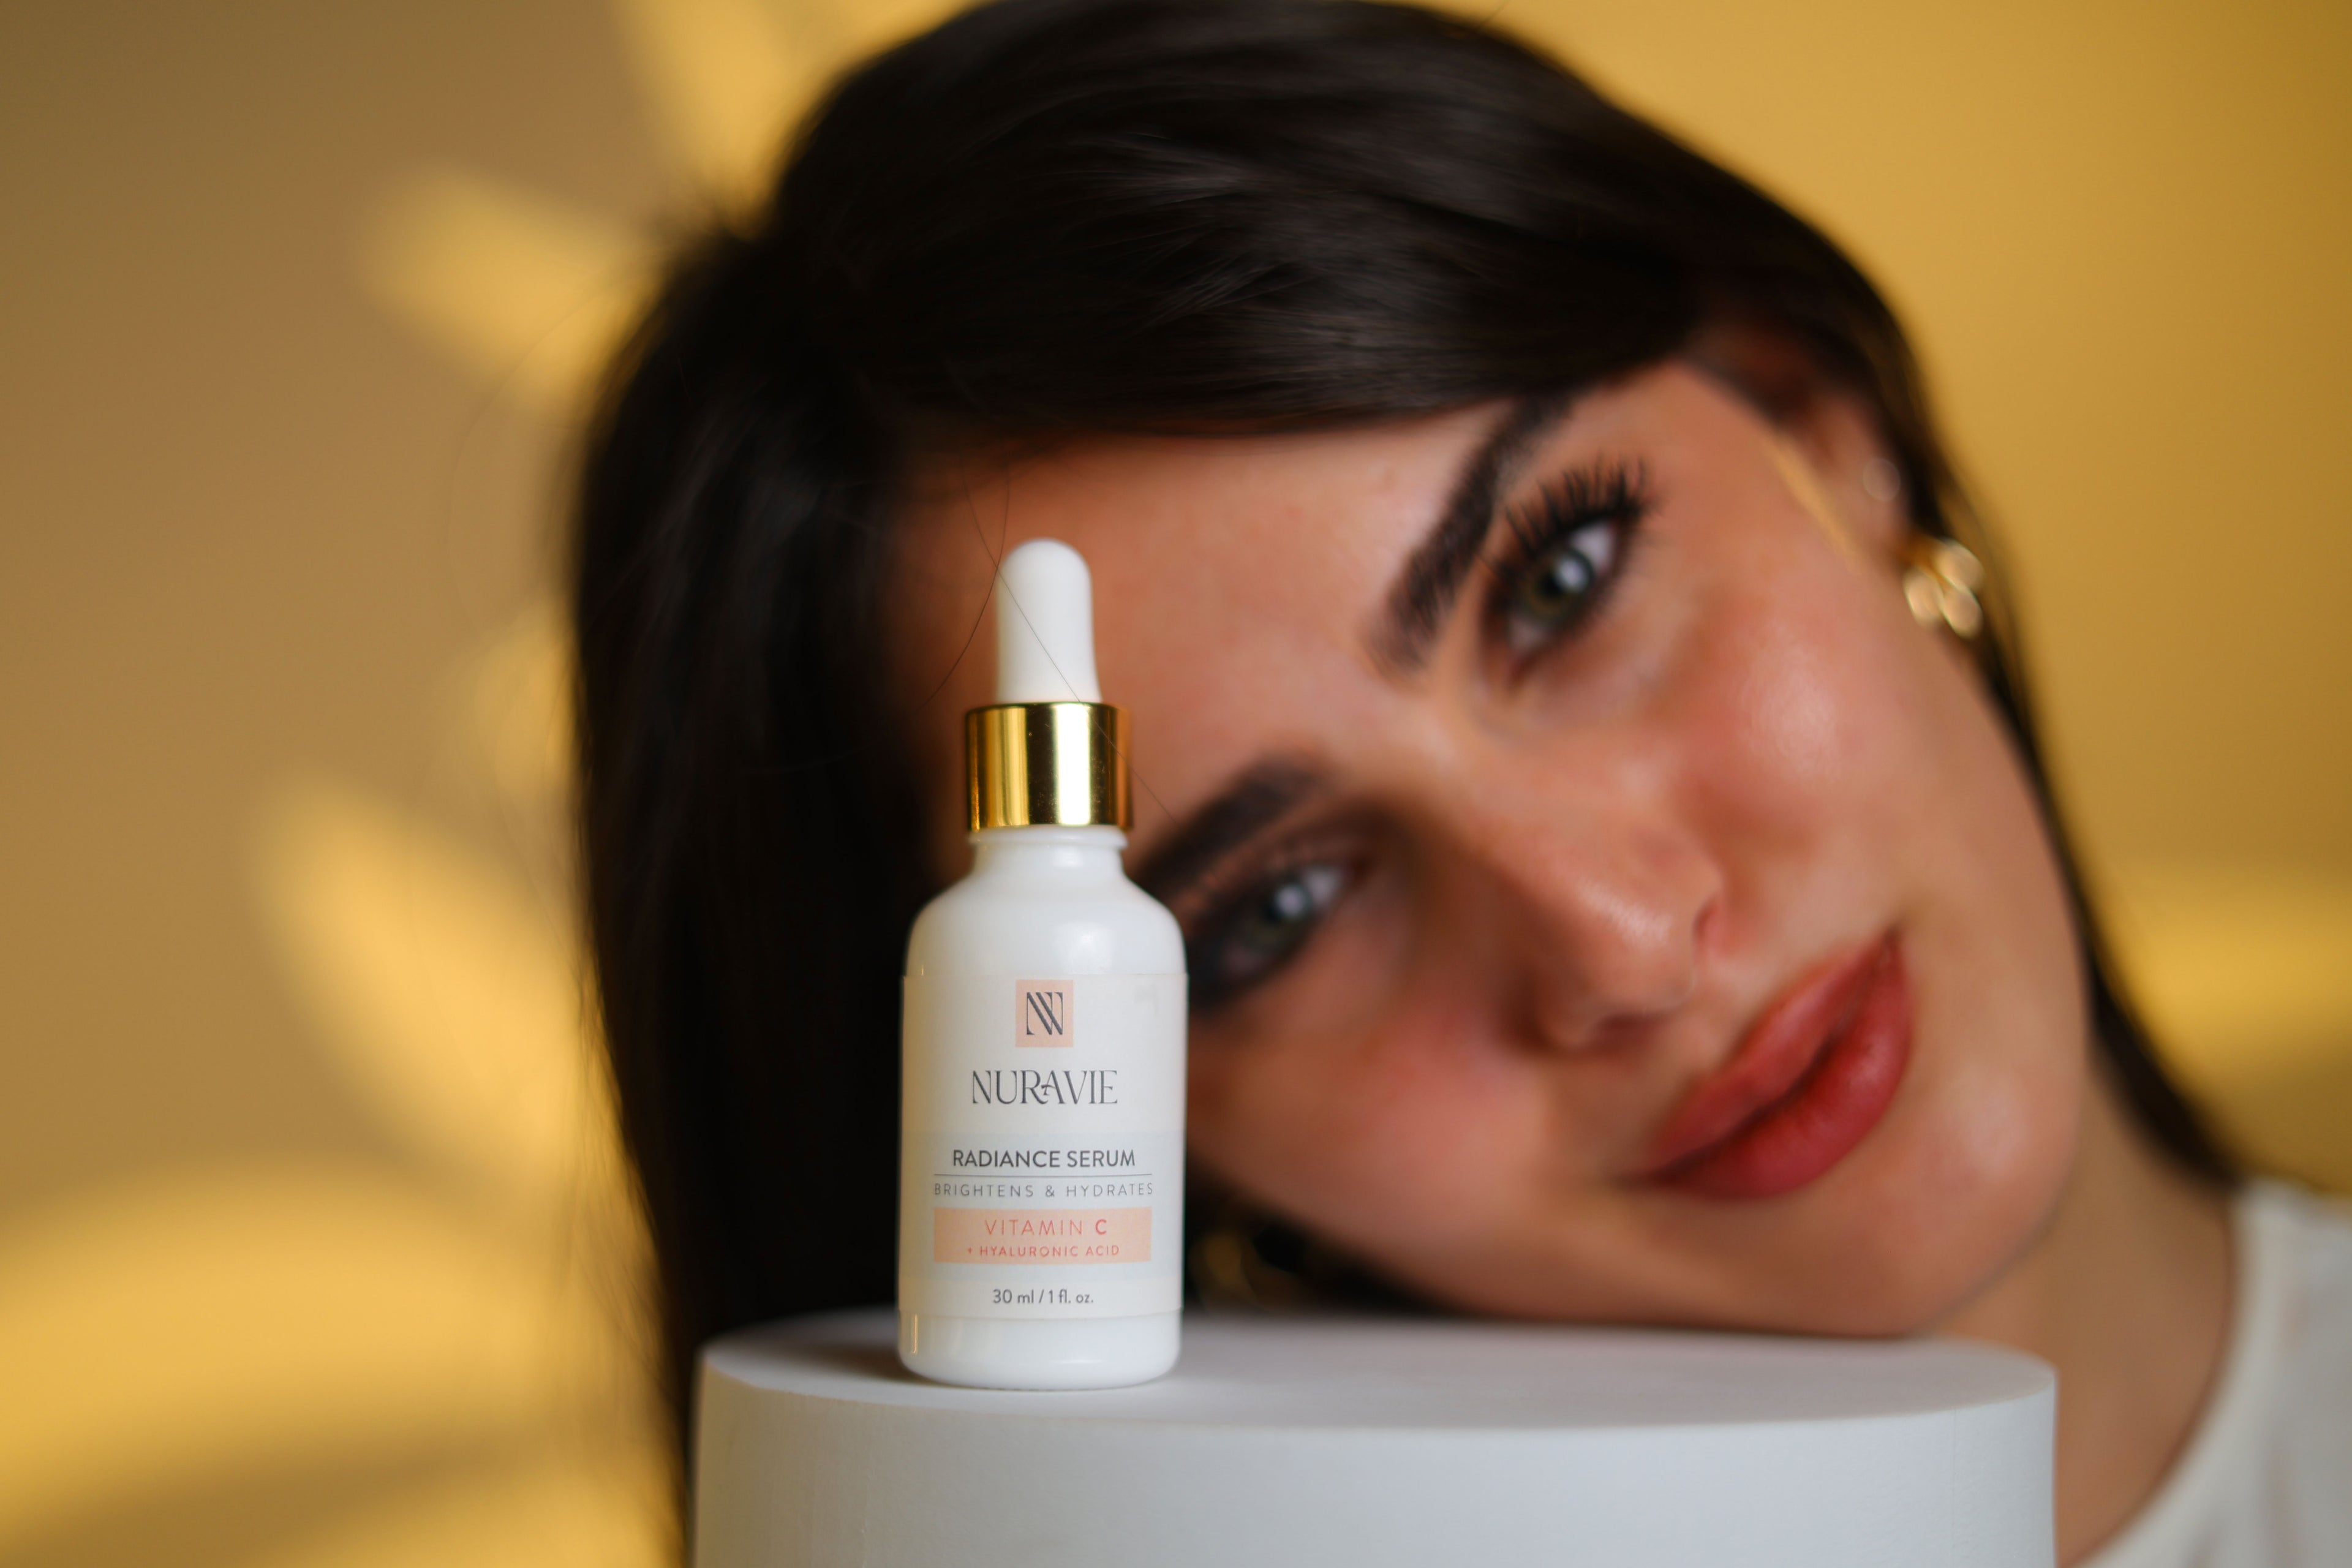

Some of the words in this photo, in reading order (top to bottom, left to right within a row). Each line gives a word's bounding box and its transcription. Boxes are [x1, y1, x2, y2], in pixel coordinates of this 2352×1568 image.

[972, 1069, 1118, 1104] NURAVIE
[953, 1150, 1061, 1167] RADIANCE
[1067, 1150, 1136, 1167] SERUM
[934, 1183, 1034, 1197] BRIGHTENS
[1045, 1184, 1055, 1197] &
[1066, 1182, 1153, 1197] HYDRATES
[984, 1219, 1082, 1235] VITAMIN
[1095, 1219, 1107, 1235] C
[979, 1245, 1079, 1257] HYALURONIC
[1085, 1245, 1120, 1256] ACID
[993, 1289, 1012, 1304] 30
[1017, 1289, 1034, 1304] ml
[1048, 1289, 1054, 1303] 1
[1058, 1288, 1071, 1304] fl.
[1076, 1293, 1094, 1304] oz.
